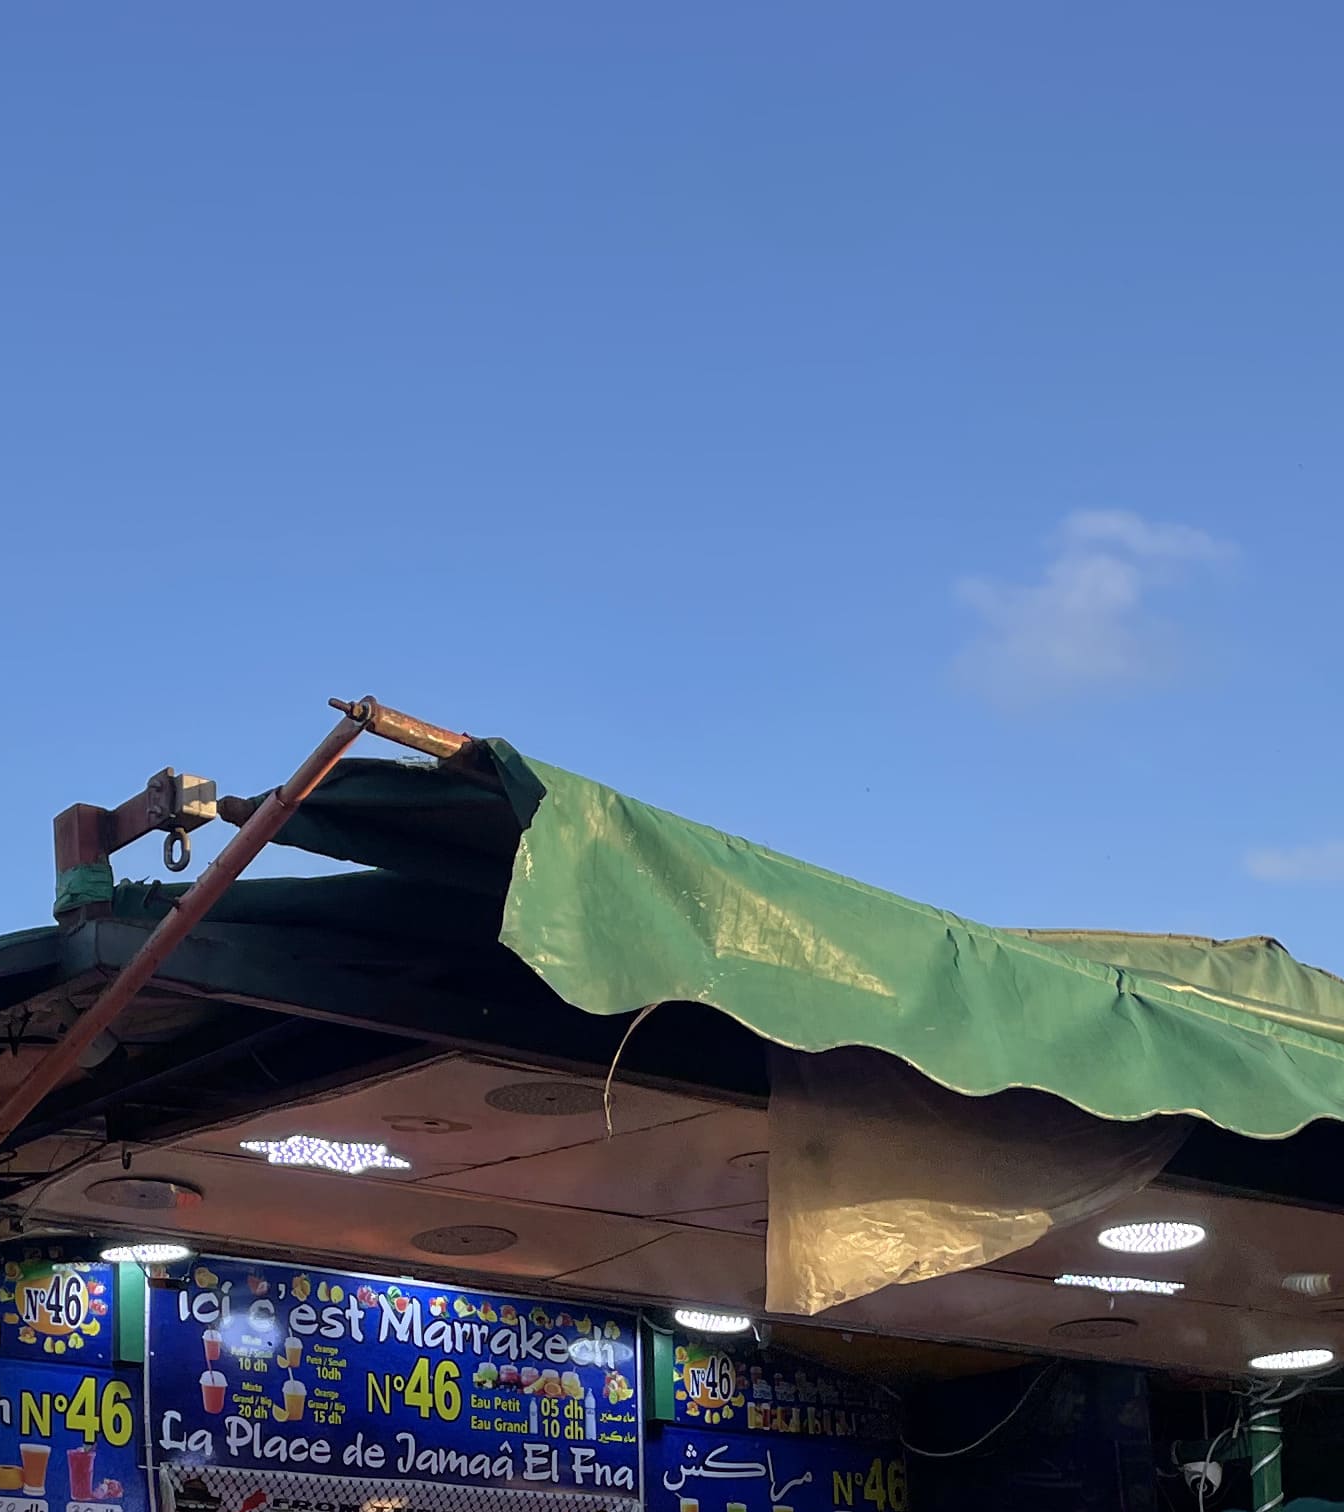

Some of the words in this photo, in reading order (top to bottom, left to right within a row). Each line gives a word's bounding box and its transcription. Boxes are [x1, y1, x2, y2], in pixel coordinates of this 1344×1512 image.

[379, 1293, 616, 1369] Marrakech
[253, 1359, 268, 1373] dh
[253, 1405, 268, 1419] dh
[327, 1412, 342, 1424] dh
[470, 1394, 491, 1409] Eau
[494, 1397, 521, 1413] Petit
[540, 1397, 560, 1417] 05
[564, 1398, 584, 1420] dh
[470, 1415, 491, 1431] Eau
[494, 1418, 528, 1434] Grand
[542, 1418, 560, 1438] 10
[564, 1420, 585, 1441] dh
[159, 1410, 214, 1456] La
[224, 1415, 332, 1464] Place
[342, 1431, 386, 1469] de
[395, 1431, 515, 1481] Jamaâ
[522, 1442, 560, 1483] El
[570, 1446, 635, 1490] Fna
[663, 1443, 814, 1503] مراكش
